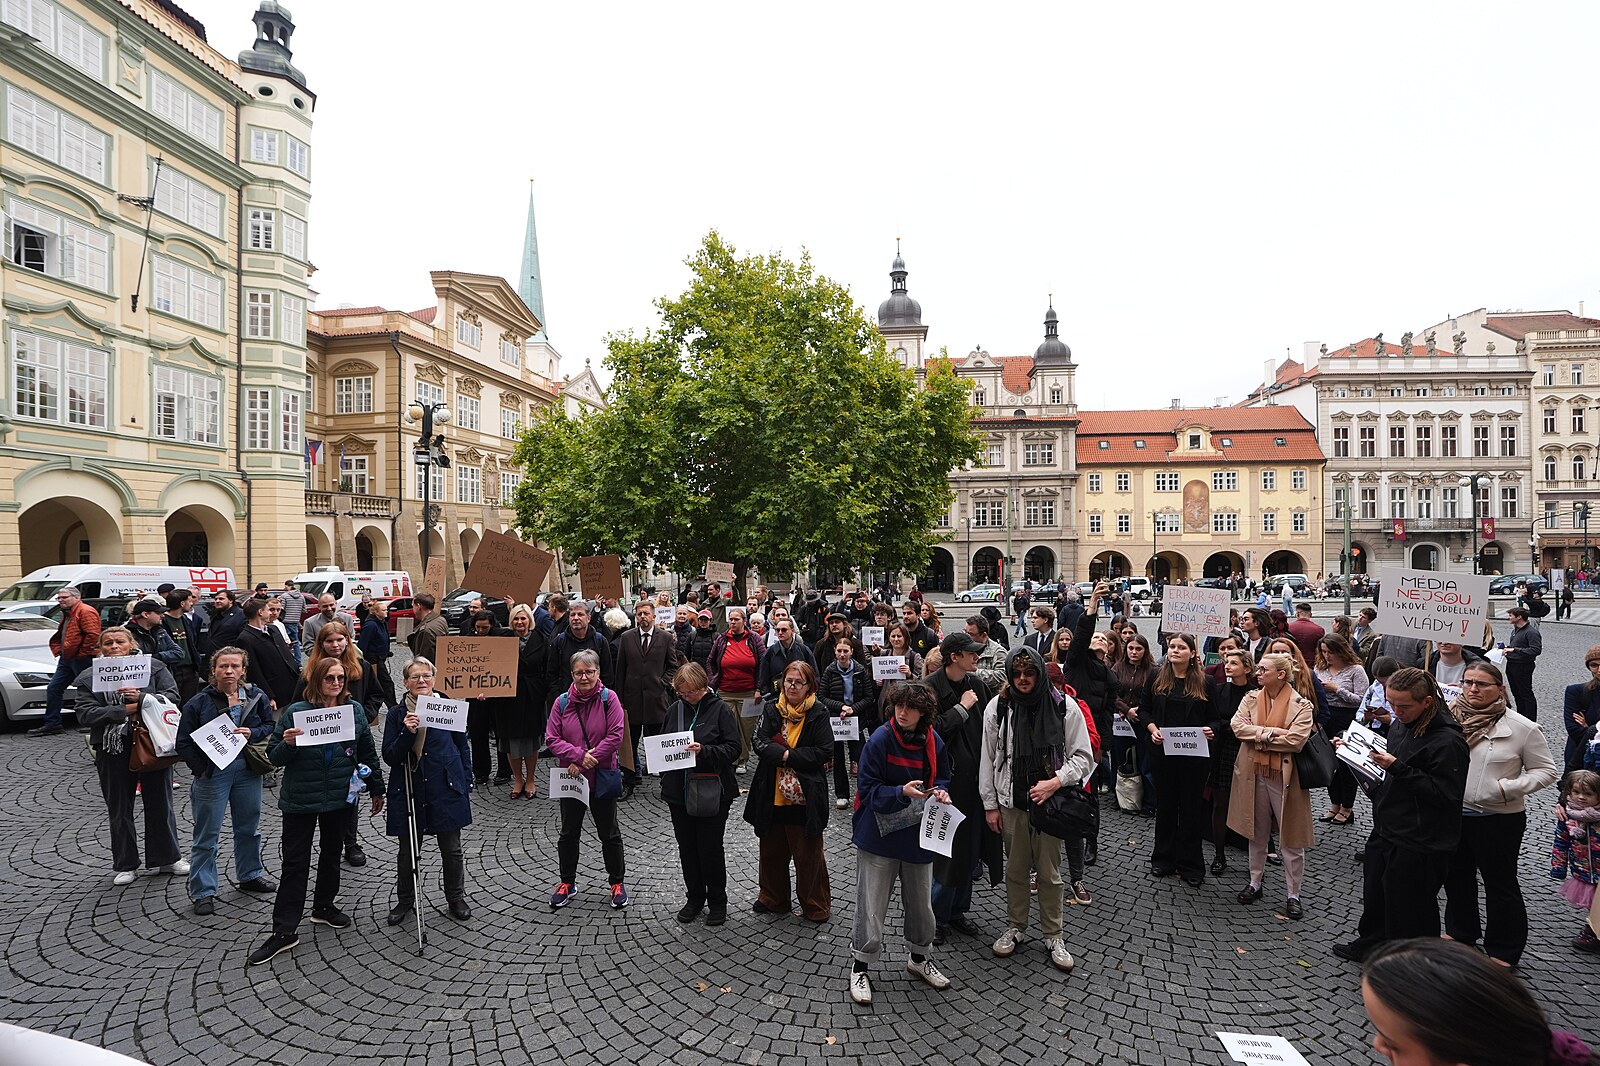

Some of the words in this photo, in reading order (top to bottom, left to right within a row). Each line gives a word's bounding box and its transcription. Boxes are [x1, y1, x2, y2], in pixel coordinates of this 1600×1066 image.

[1401, 575, 1457, 591] MÉDIA
[1169, 589, 1205, 601] ERROR
[1208, 592, 1226, 604] 404
[1397, 588, 1471, 605] NEJSOU
[1168, 601, 1218, 614] NEZÁVISLÁ
[1385, 600, 1428, 611] TISKOVÉ
[1436, 605, 1481, 616] ODDĚLENÍ
[1402, 614, 1453, 633] VLÁDY
[447, 641, 480, 655] ŘEŠTE
[447, 651, 492, 664] KRAJSKÉ
[98, 664, 146, 673] POPLATKY
[100, 673, 144, 682] NEDÁME!!
[444, 675, 463, 690] NE
[469, 671, 512, 688] MÉDIA
[426, 702, 442, 711] RUCE
[442, 703, 458, 713] PRYČ
[306, 714, 324, 723] RUCE
[324, 711, 342, 722] PRYČ
[219, 724, 231, 738] RUCE
[309, 727, 320, 737] OD
[320, 725, 341, 735] MÉDIÍ!
[206, 734, 216, 743] OD
[660, 739, 675, 748] RUCE
[676, 736, 690, 746] PRYČ
[928, 805, 940, 820] PRYČ
[925, 820, 935, 838] RUCE
[938, 830, 946, 841] OD
